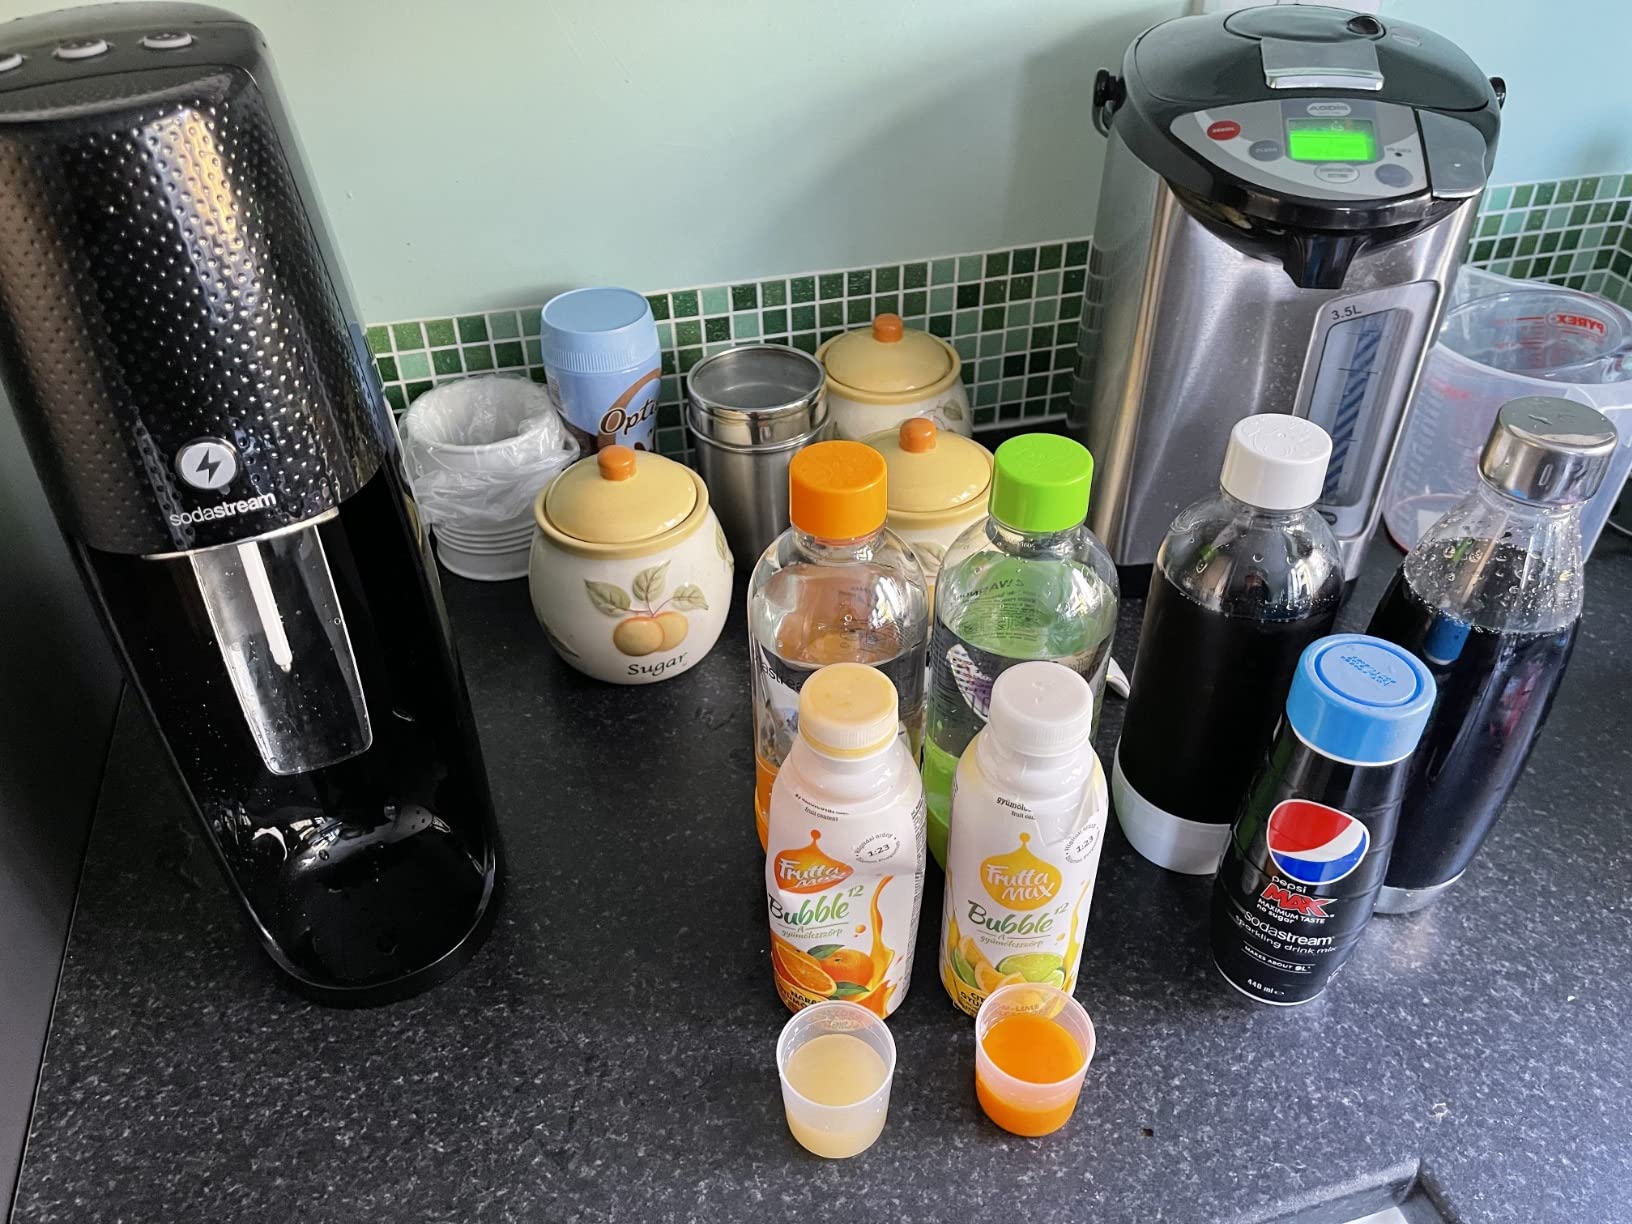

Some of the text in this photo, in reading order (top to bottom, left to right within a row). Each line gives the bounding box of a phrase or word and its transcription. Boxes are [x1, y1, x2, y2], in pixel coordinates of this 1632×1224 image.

[1331, 304, 1362, 320] 3.5L
[169, 492, 277, 527] sodastream
[627, 651, 688, 677] Sugar
[868, 844, 890, 857] 1:23
[779, 857, 840, 881] Frutta
[985, 863, 1049, 887] Frutta
[1271, 875, 1308, 894] pepsi
[768, 892, 850, 926] Bubble
[1258, 898, 1326, 924] MAXIMUM TASTE
[1260, 882, 1338, 918] MAX
[967, 899, 1054, 935] Bubble
[1256, 903, 1295, 925] no sugar
[1235, 915, 1338, 955] sparkling drink mix
[1244, 911, 1333, 946] sodastream
[1267, 958, 1294, 969] ABOUT
